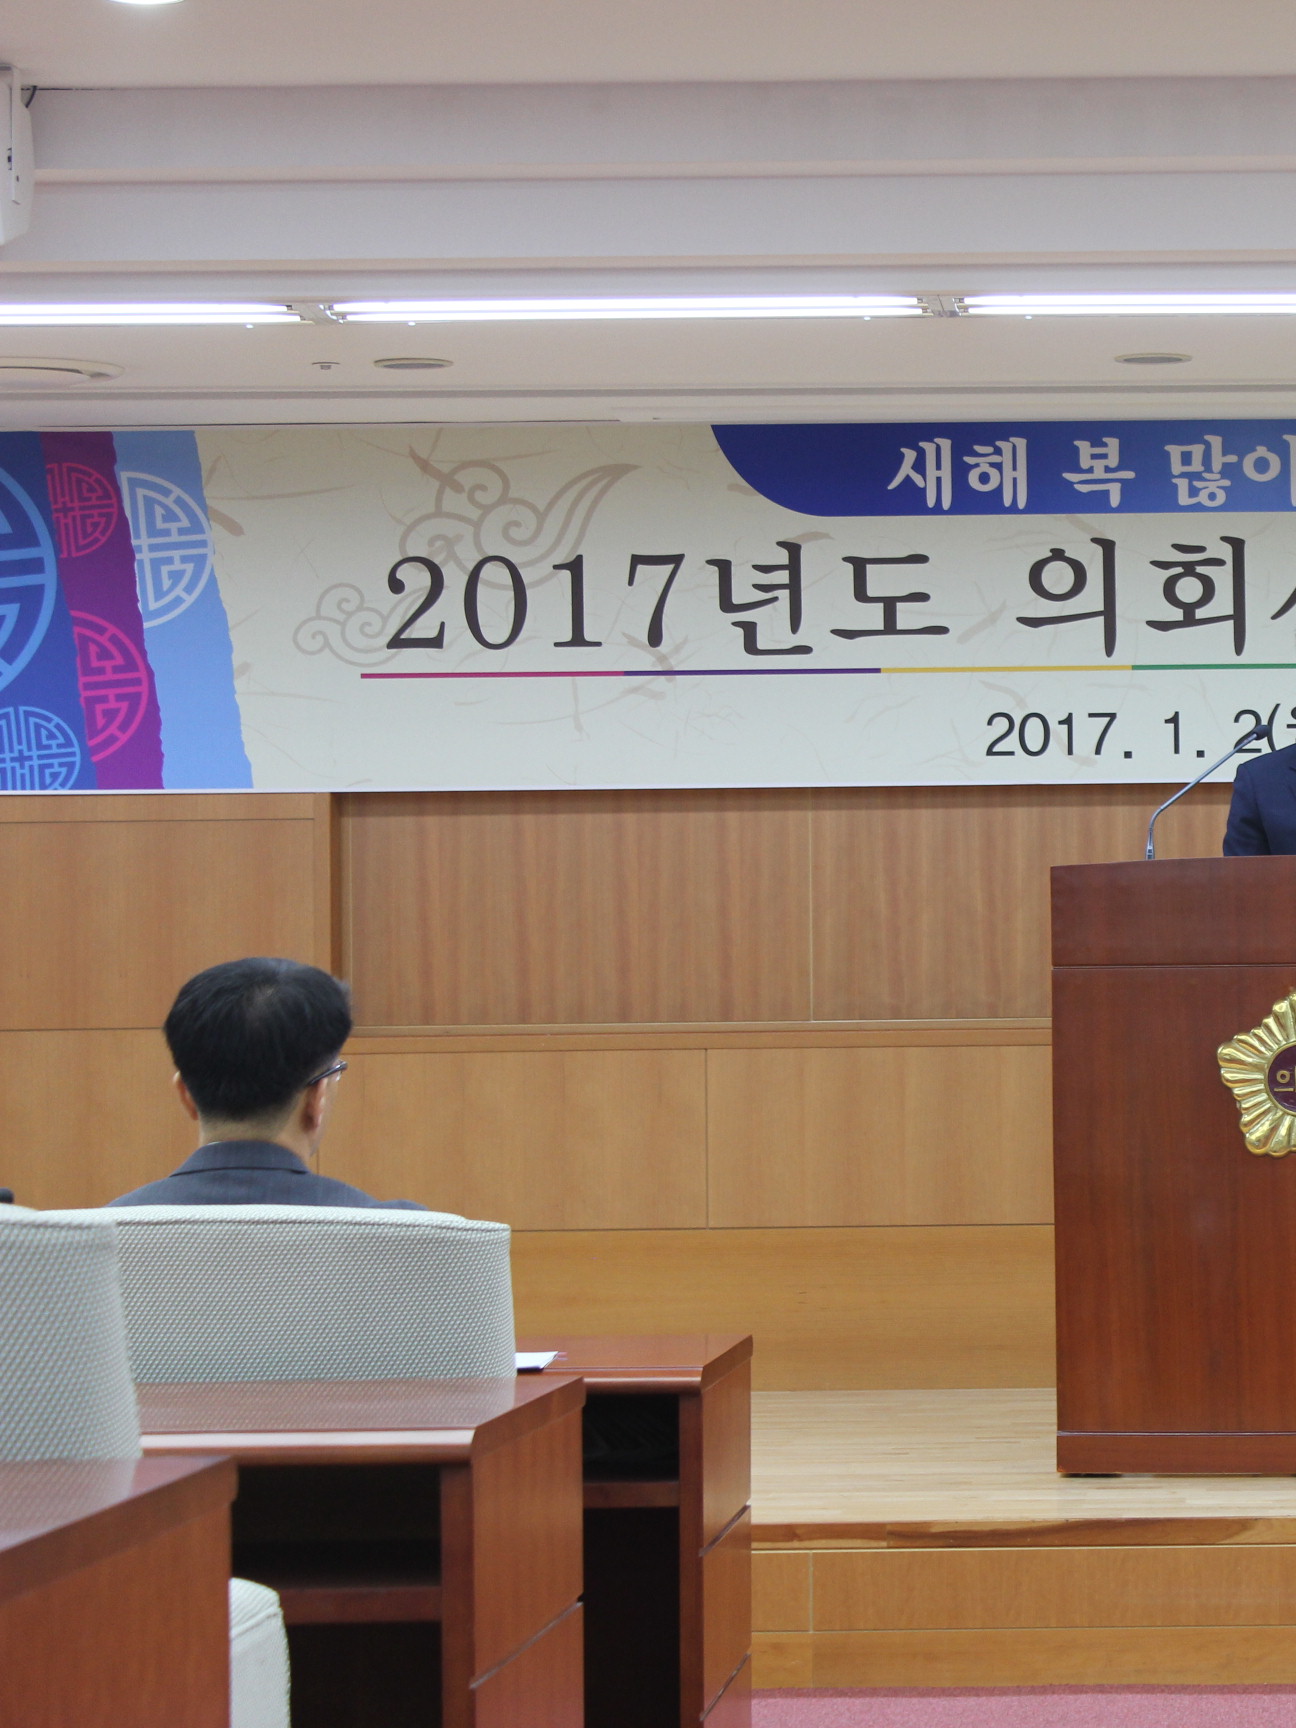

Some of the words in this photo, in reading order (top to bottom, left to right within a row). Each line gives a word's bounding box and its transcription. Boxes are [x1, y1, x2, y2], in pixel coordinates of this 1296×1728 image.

[887, 437, 1028, 511] 새해
[1061, 437, 1136, 509] 복
[386, 540, 951, 656] 2017년도
[986, 711, 1133, 759] 2017.
[1164, 711, 1205, 758] 1.
